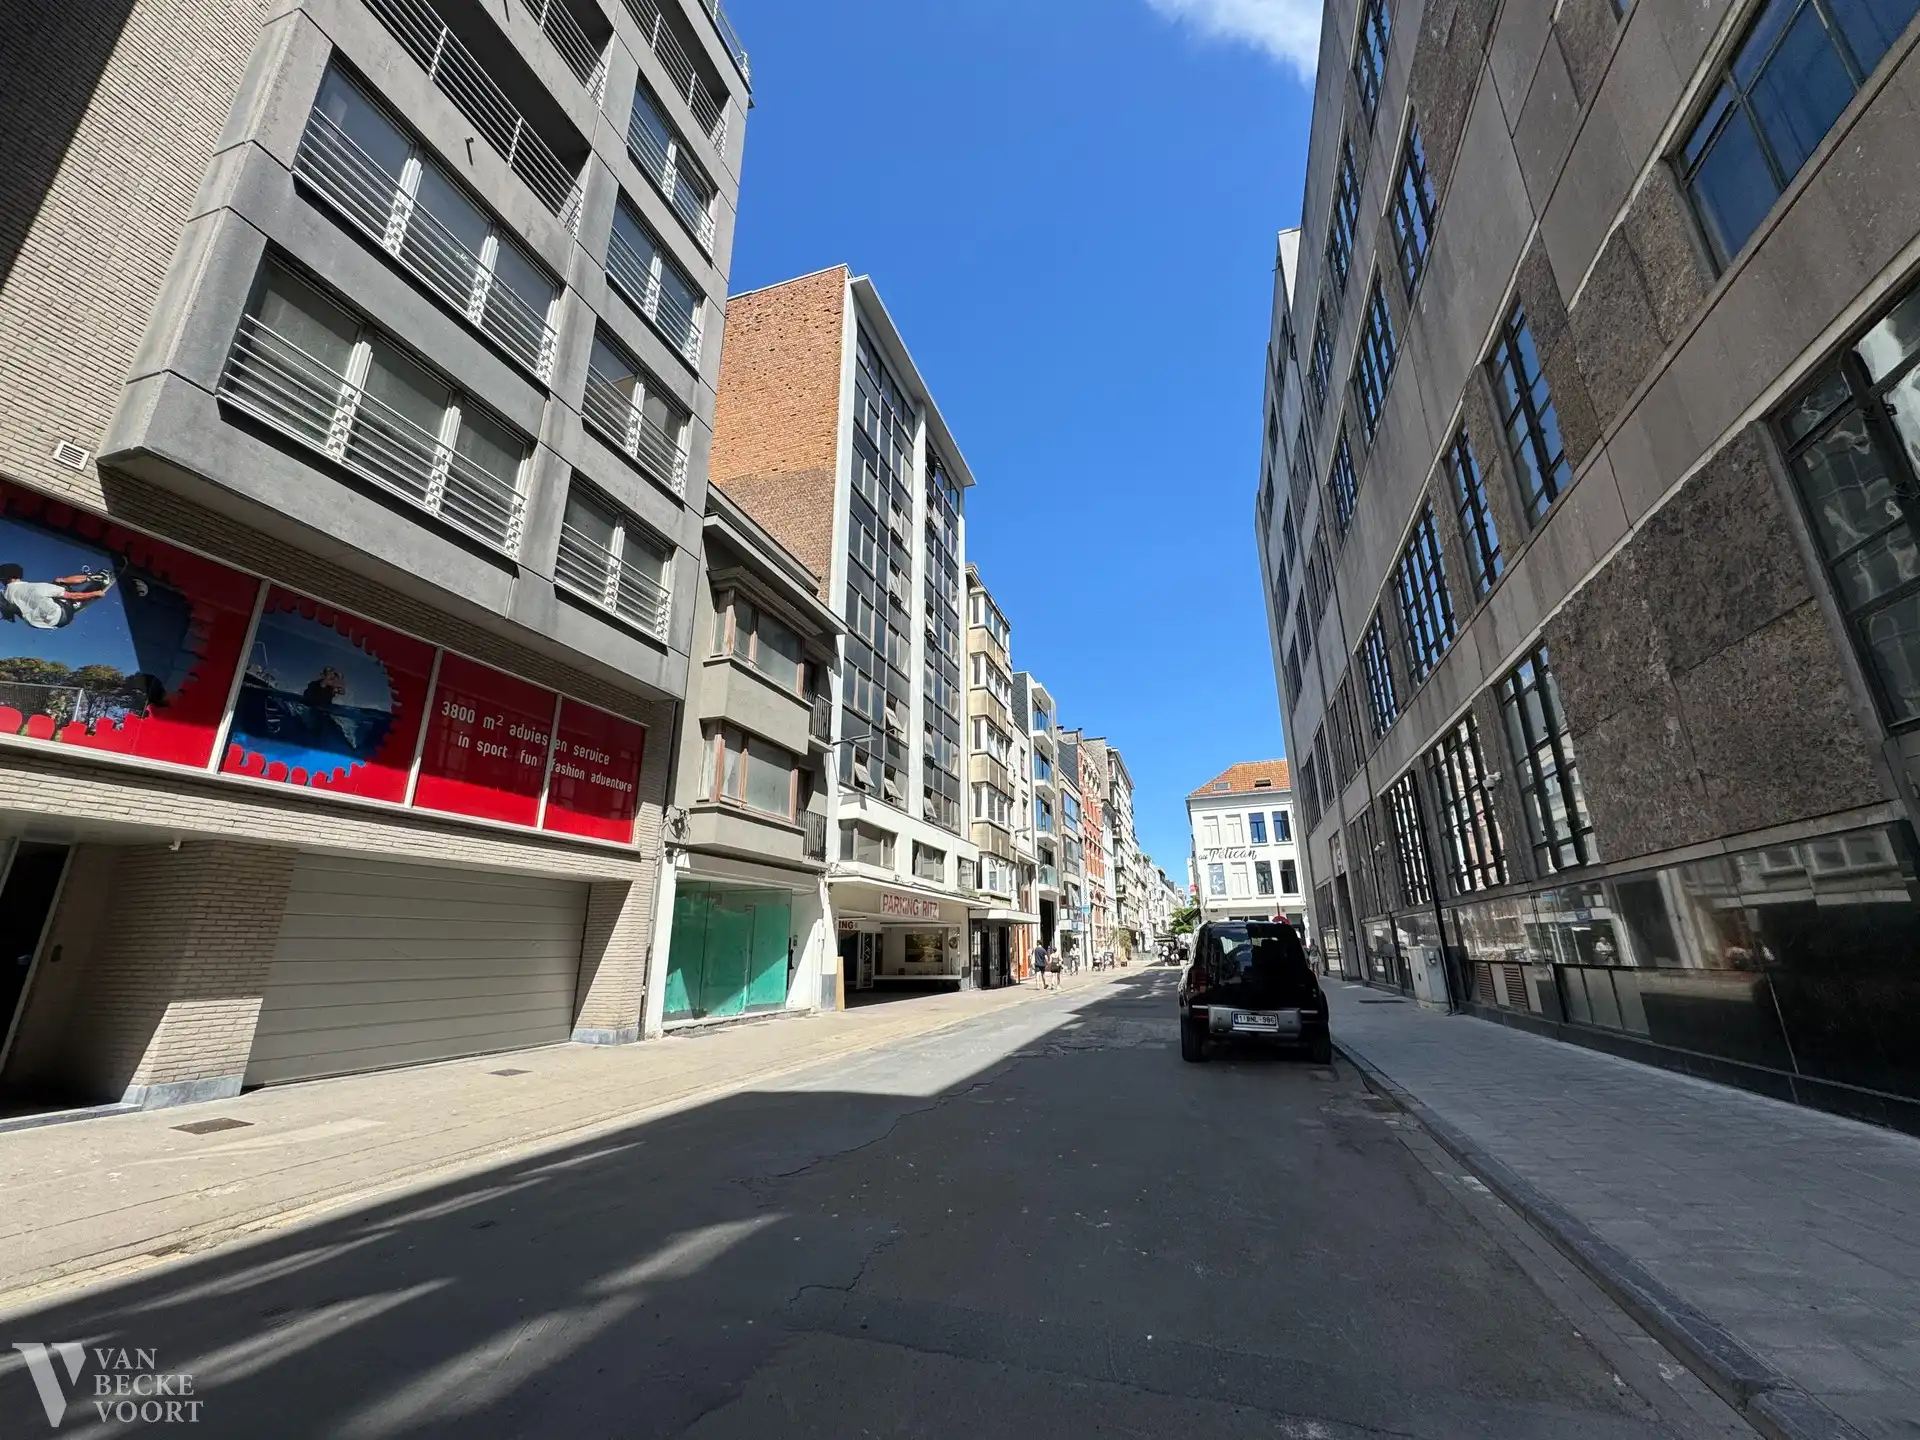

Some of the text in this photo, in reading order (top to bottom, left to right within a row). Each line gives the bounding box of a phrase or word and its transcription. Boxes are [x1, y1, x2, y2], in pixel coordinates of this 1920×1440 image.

[441, 700, 476, 724] 3800
[509, 720, 549, 746] advies
[554, 738, 568, 753] en
[573, 743, 610, 765] service
[457, 730, 633, 793] in sport fun fashion adventure
[882, 893, 938, 919] PARKING RITZ
